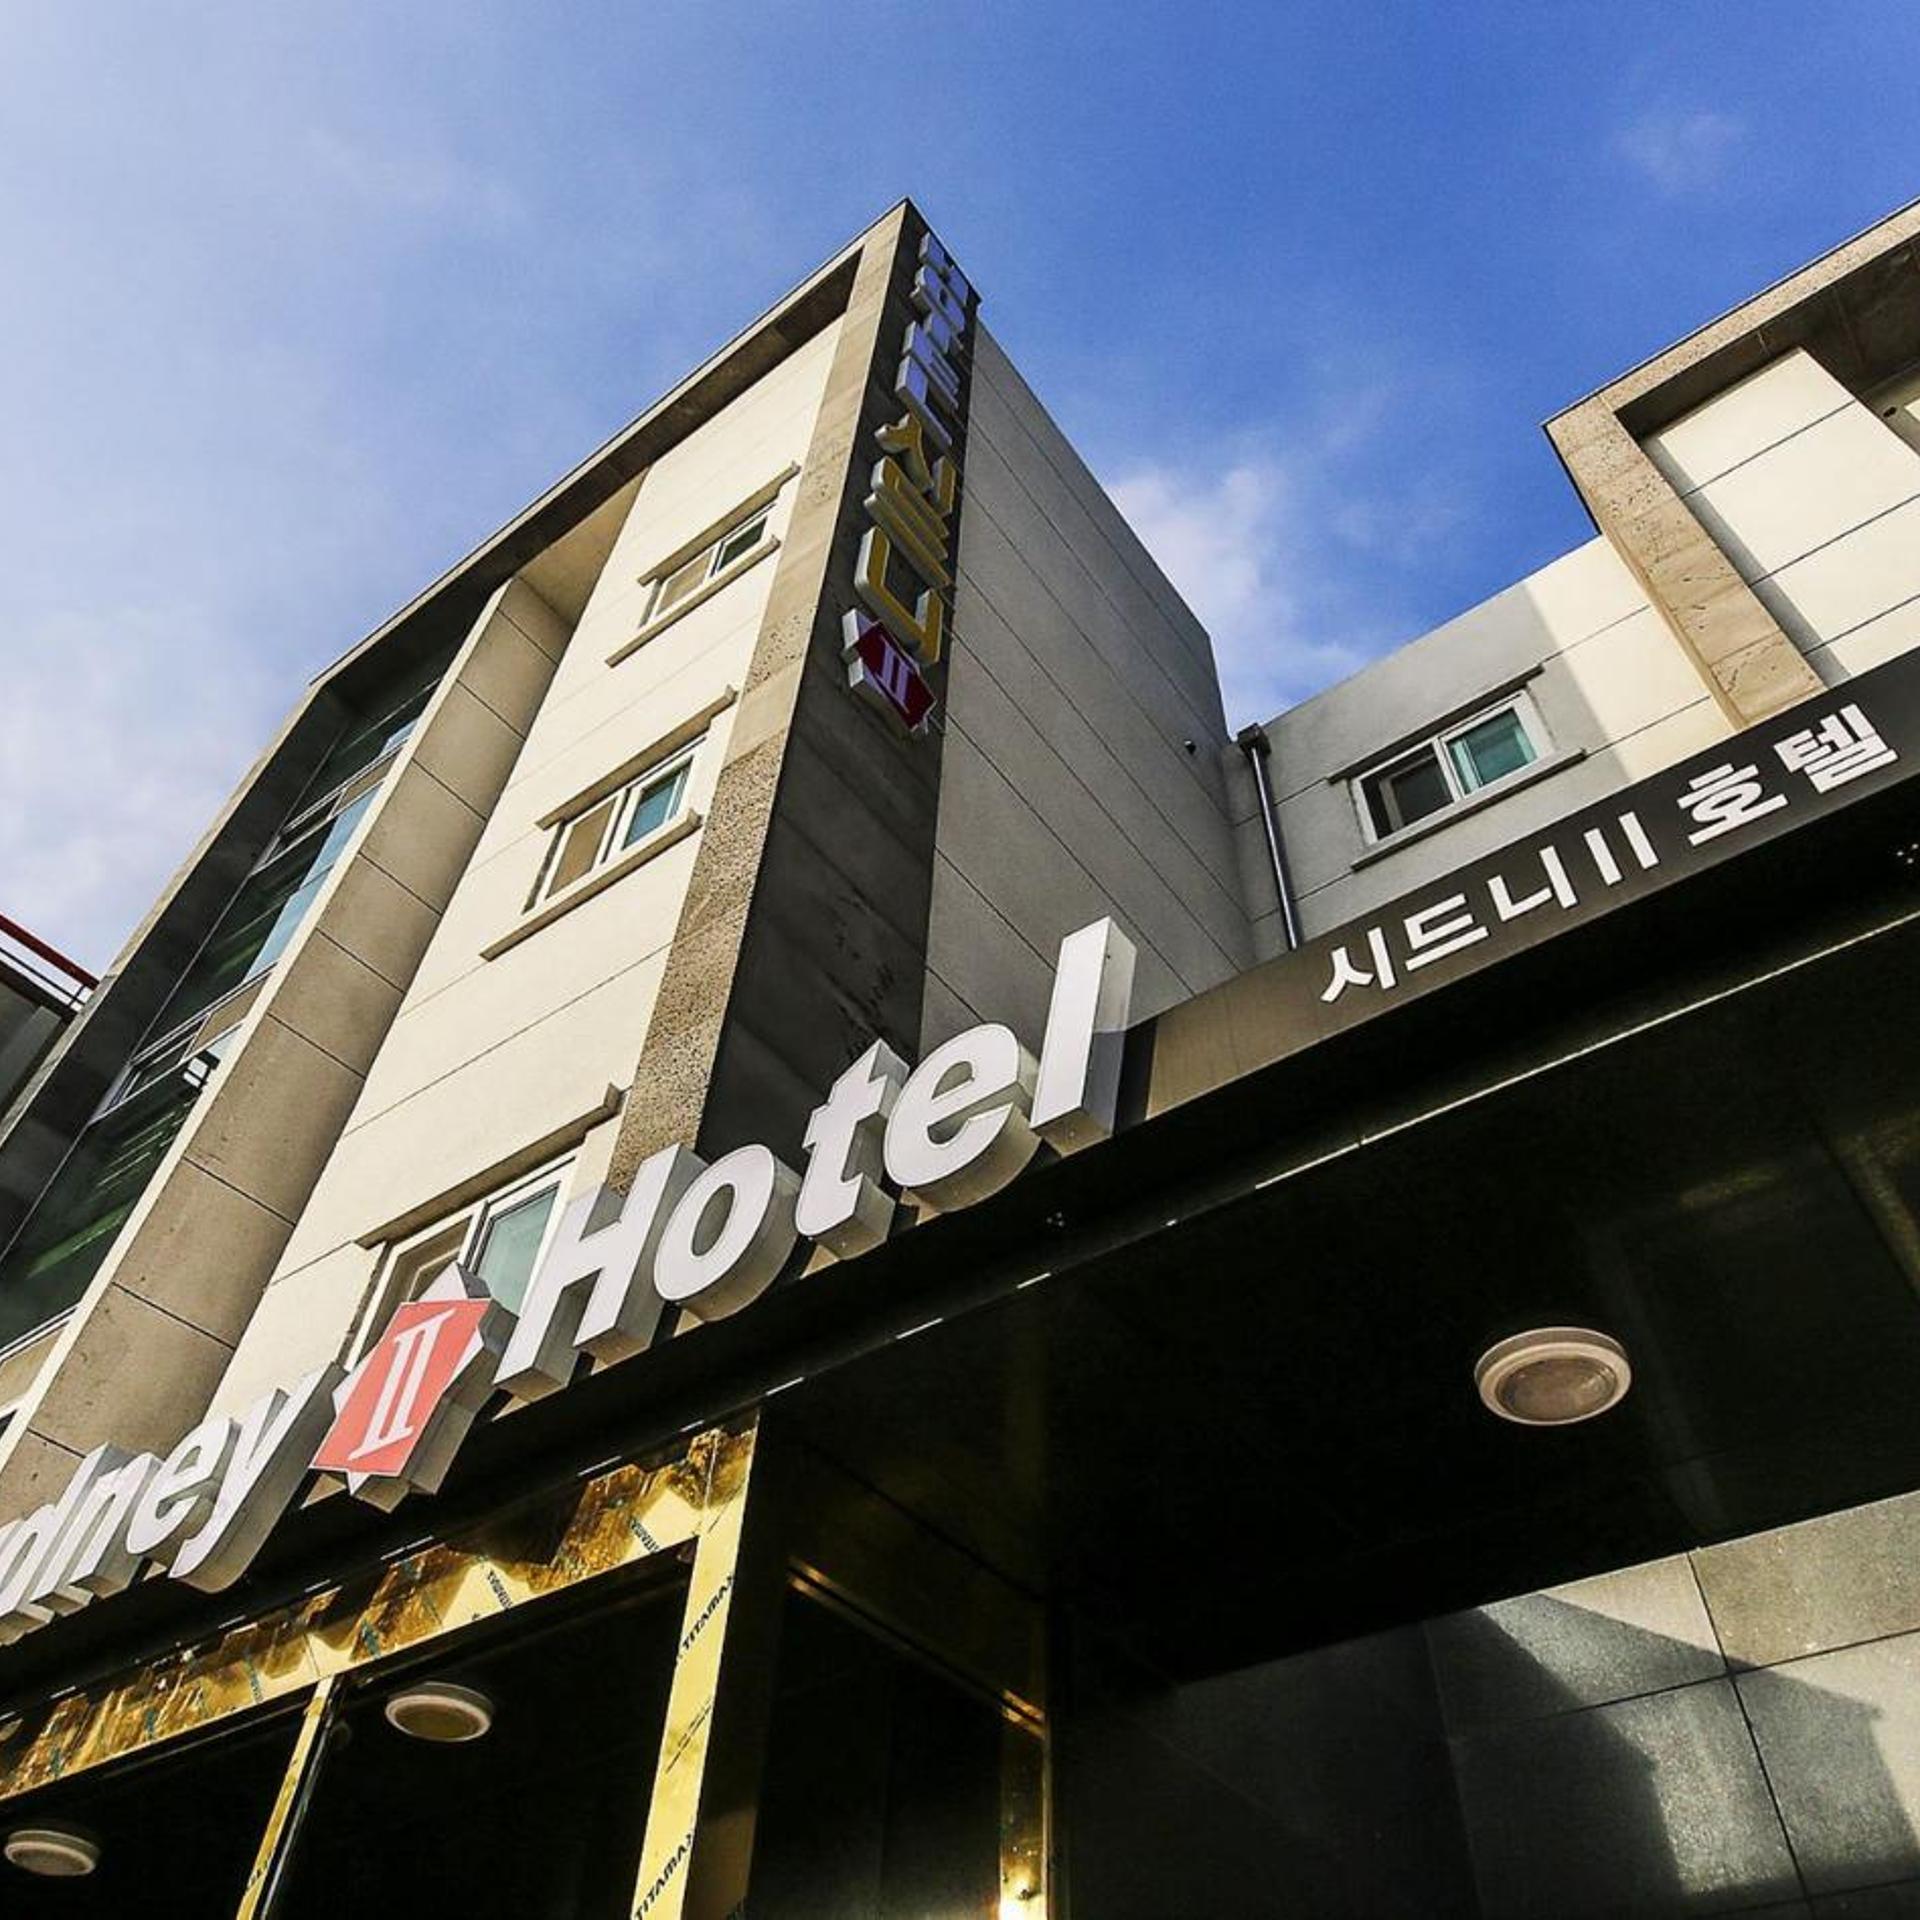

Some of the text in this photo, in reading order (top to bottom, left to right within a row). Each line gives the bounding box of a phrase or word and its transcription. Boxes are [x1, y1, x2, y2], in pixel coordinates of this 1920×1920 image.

[855, 411, 956, 665] 시드니
[1677, 703, 1898, 847] 호텔
[0, 1364, 336, 1620] dney
[494, 916, 1118, 1388] Hotel
